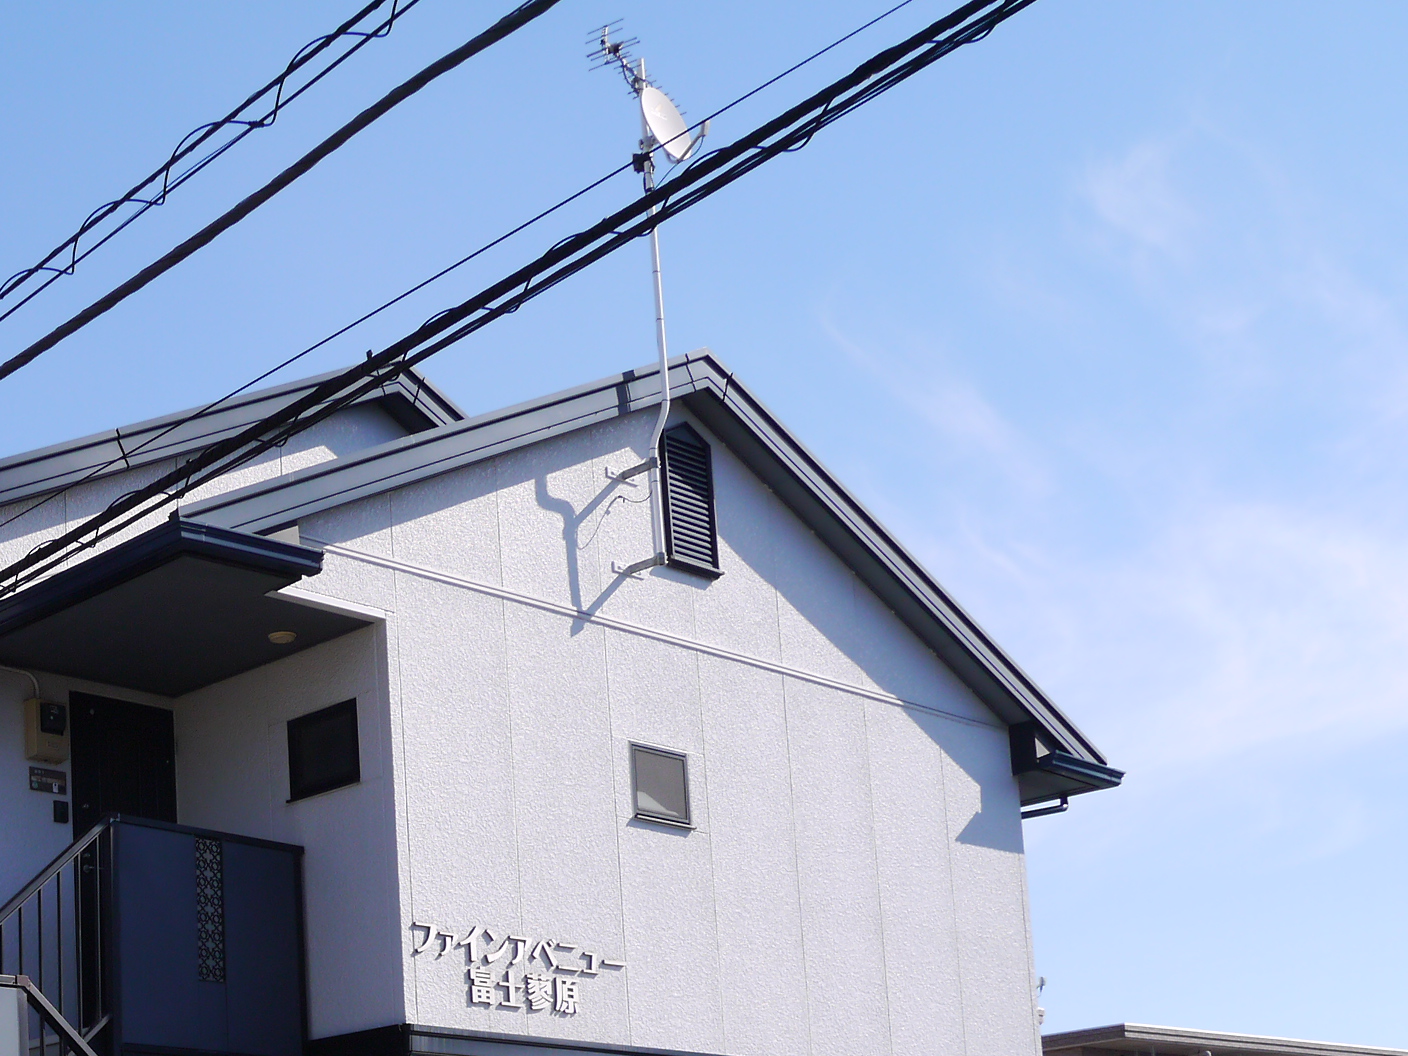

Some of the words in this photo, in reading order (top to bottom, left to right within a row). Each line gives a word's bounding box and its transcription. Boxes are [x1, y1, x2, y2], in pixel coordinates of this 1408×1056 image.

[412, 922, 626, 975] ファインアベニュー
[468, 966, 579, 1014] 富士蓼原
